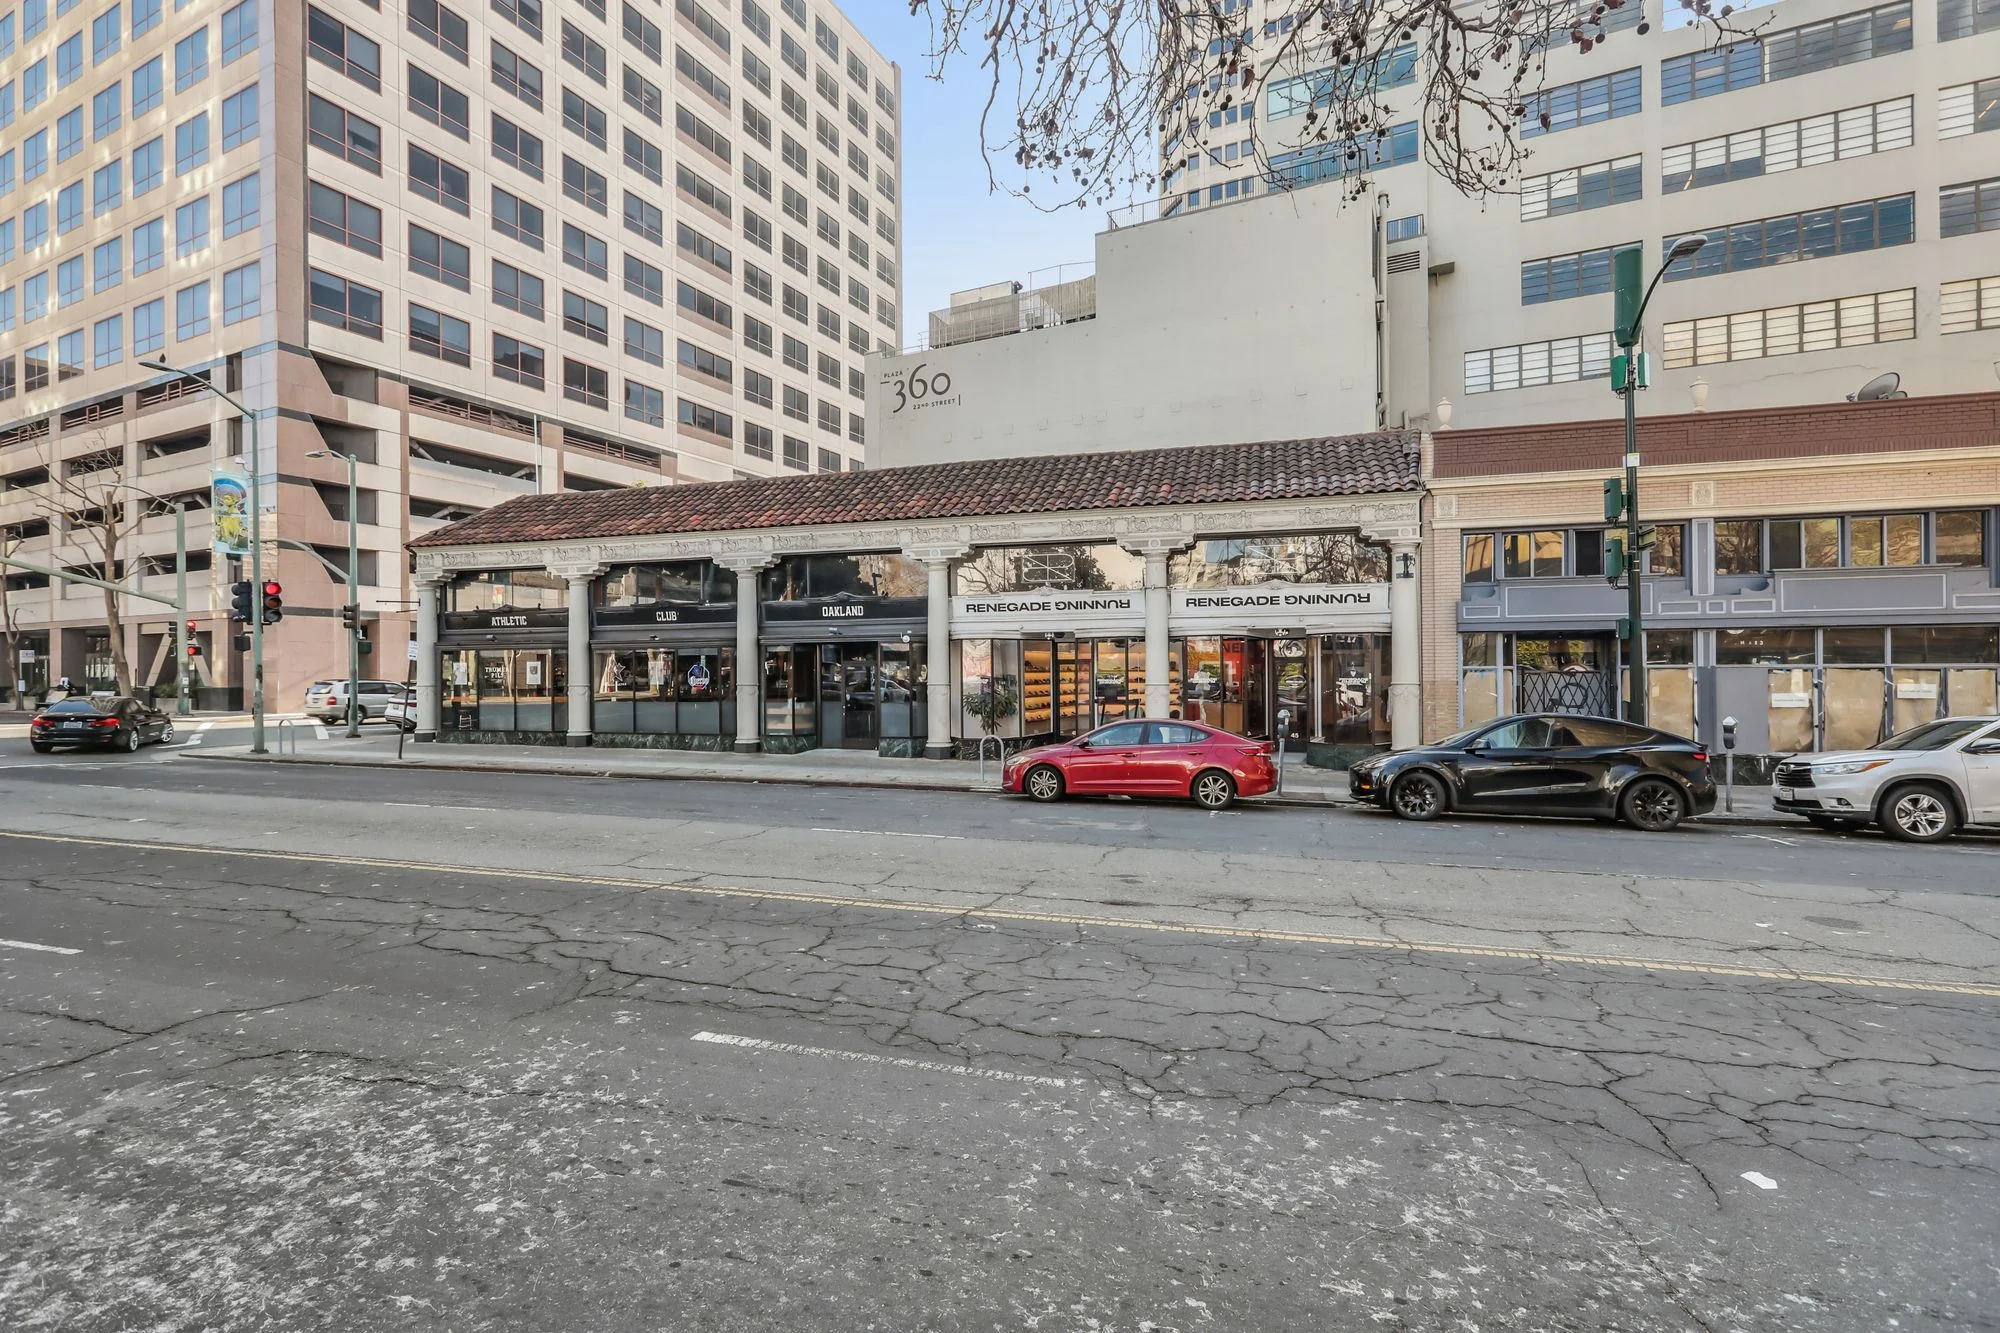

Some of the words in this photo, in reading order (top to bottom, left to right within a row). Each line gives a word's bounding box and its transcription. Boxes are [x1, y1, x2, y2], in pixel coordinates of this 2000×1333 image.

[893, 363, 951, 413] 360
[931, 399, 955, 407] STREET
[966, 601, 1051, 613] RENEGADE
[1054, 598, 1131, 611] RUNNING
[1186, 596, 1280, 607] RENEGADE
[1284, 592, 1371, 606] RUNNING
[656, 611, 677, 621] CLUB
[822, 605, 864, 617] OAKLAND
[491, 615, 528, 626] ATHLETIC
